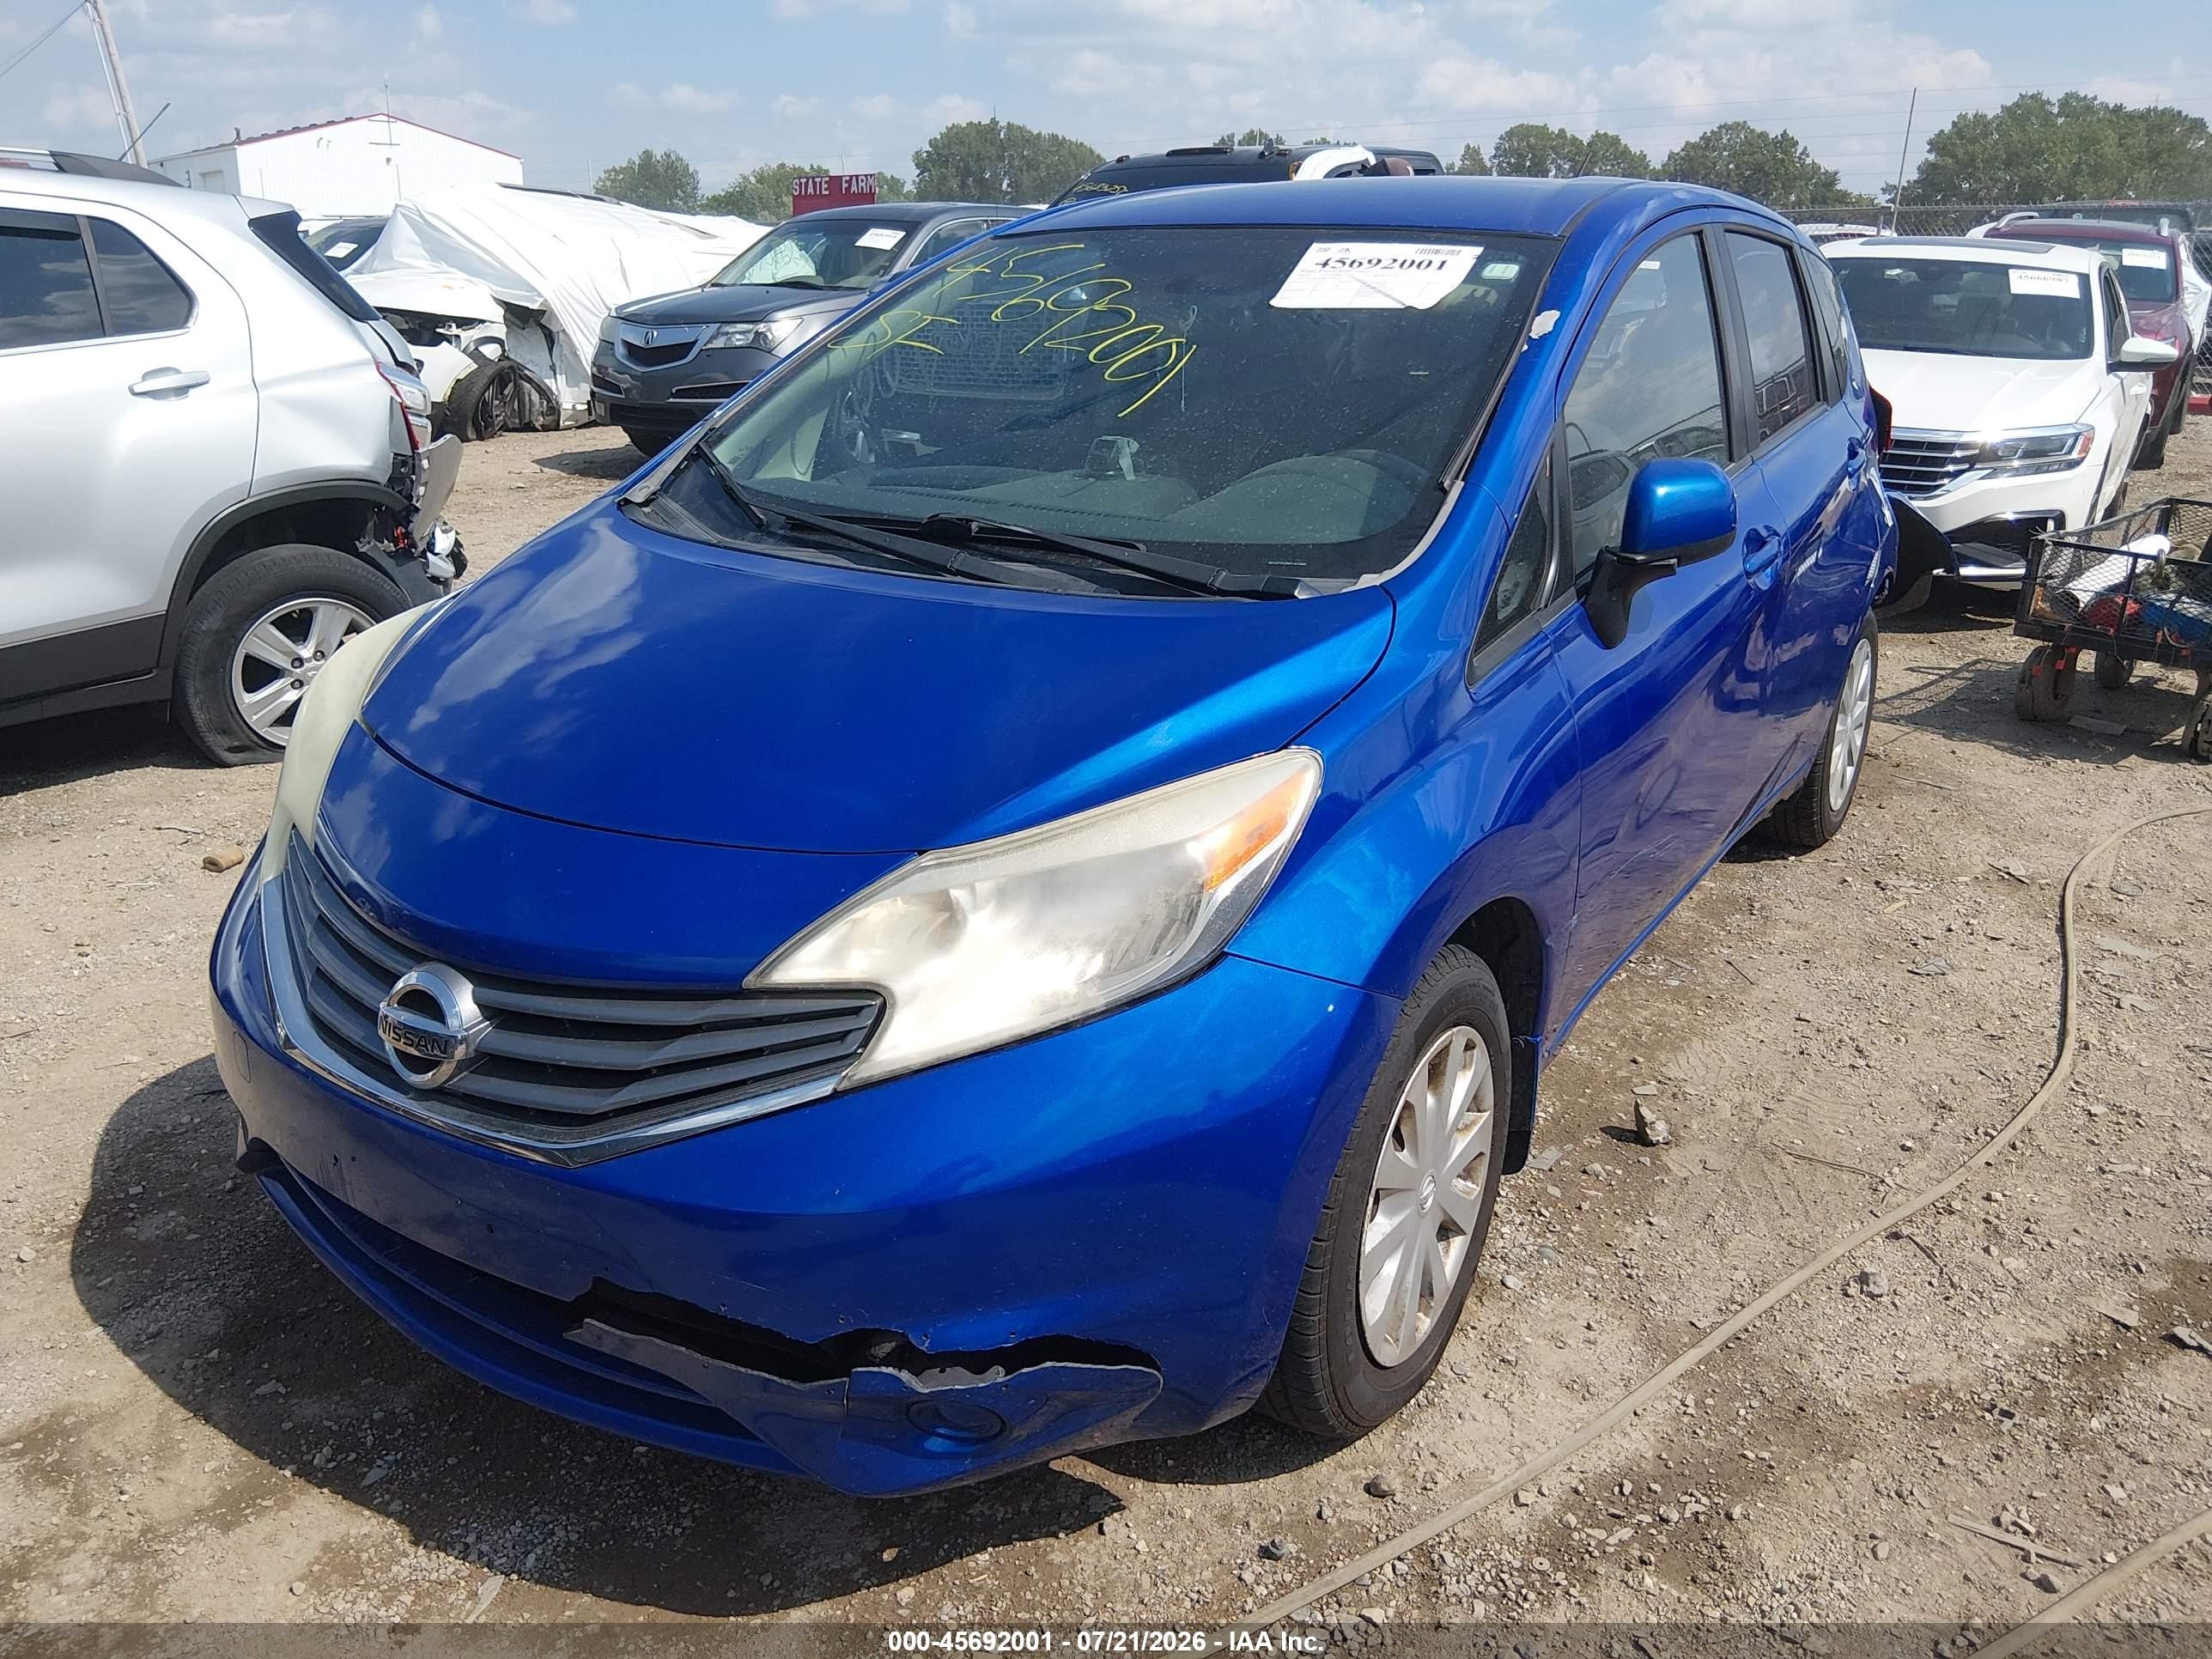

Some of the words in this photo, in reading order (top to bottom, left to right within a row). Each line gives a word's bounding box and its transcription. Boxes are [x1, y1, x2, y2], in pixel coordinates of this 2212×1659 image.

[793, 178, 830, 196] STATE
[1314, 256, 1449, 270] 45692001
[380, 1016, 447, 1054] NISSAN
